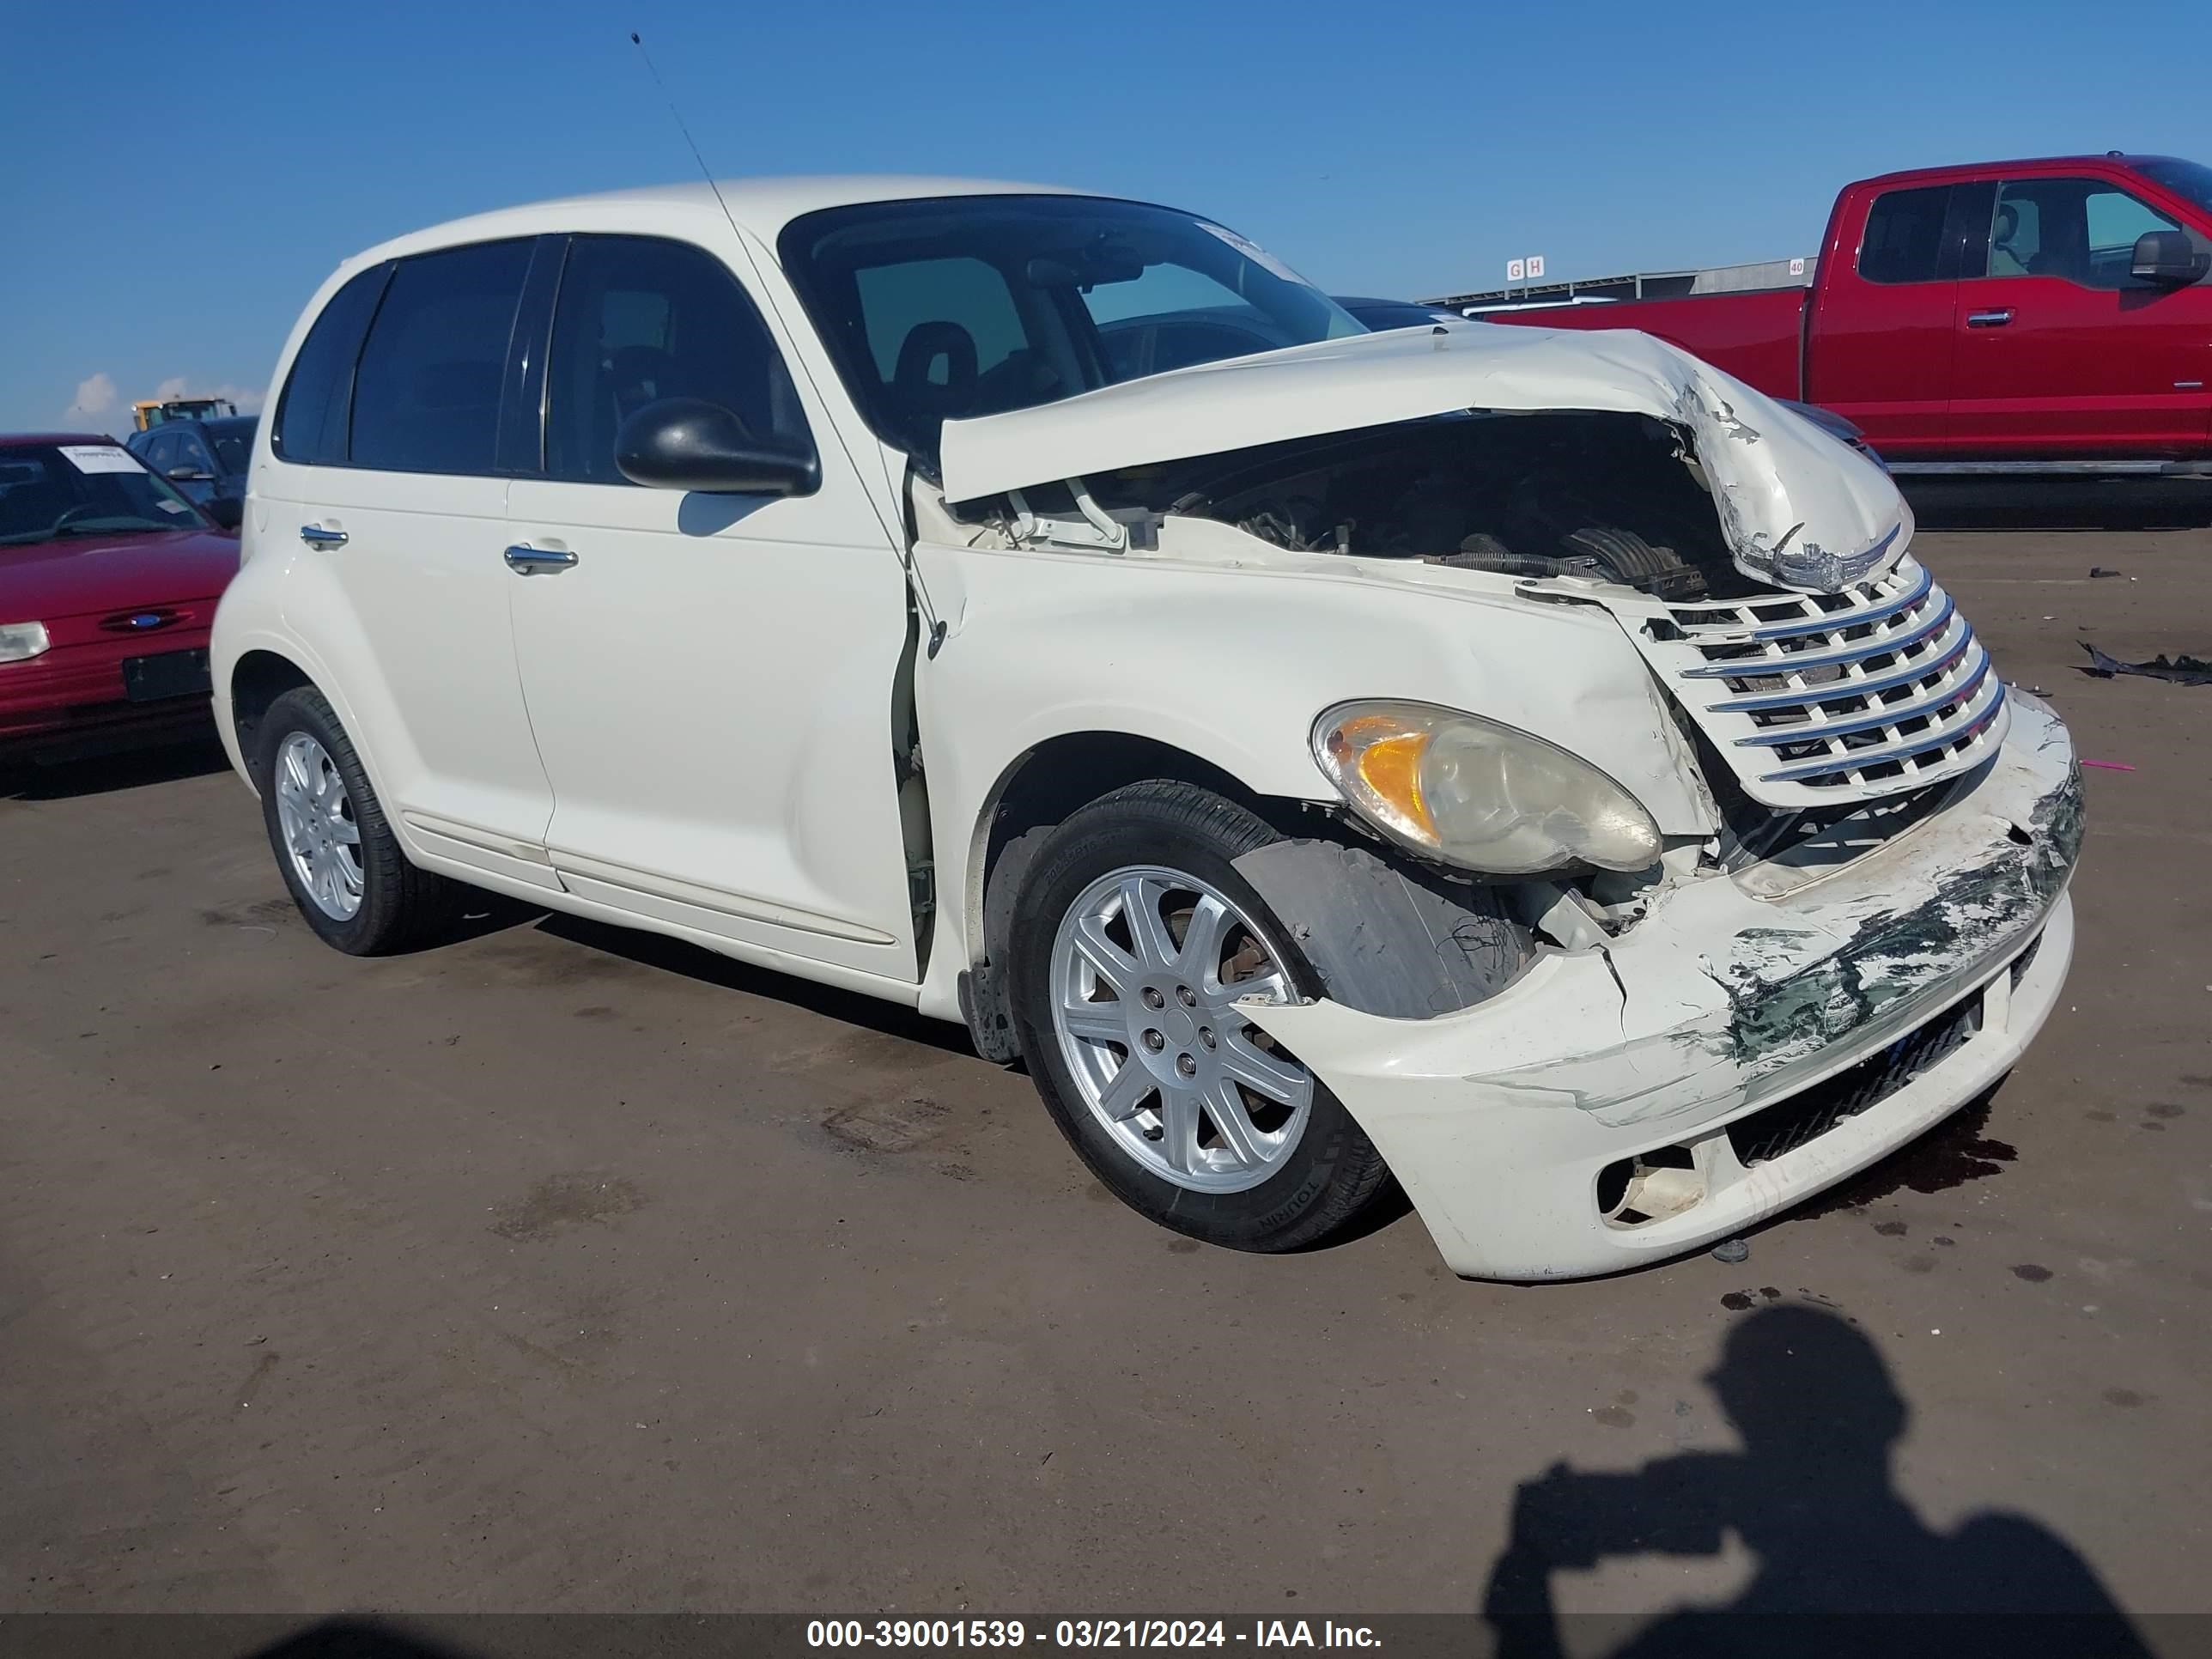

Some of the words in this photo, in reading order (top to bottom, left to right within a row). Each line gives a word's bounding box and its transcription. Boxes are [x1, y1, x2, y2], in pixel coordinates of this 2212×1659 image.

[1511, 264, 1521, 277] G
[1530, 260, 1540, 274] H
[1791, 262, 1802, 272] 40
